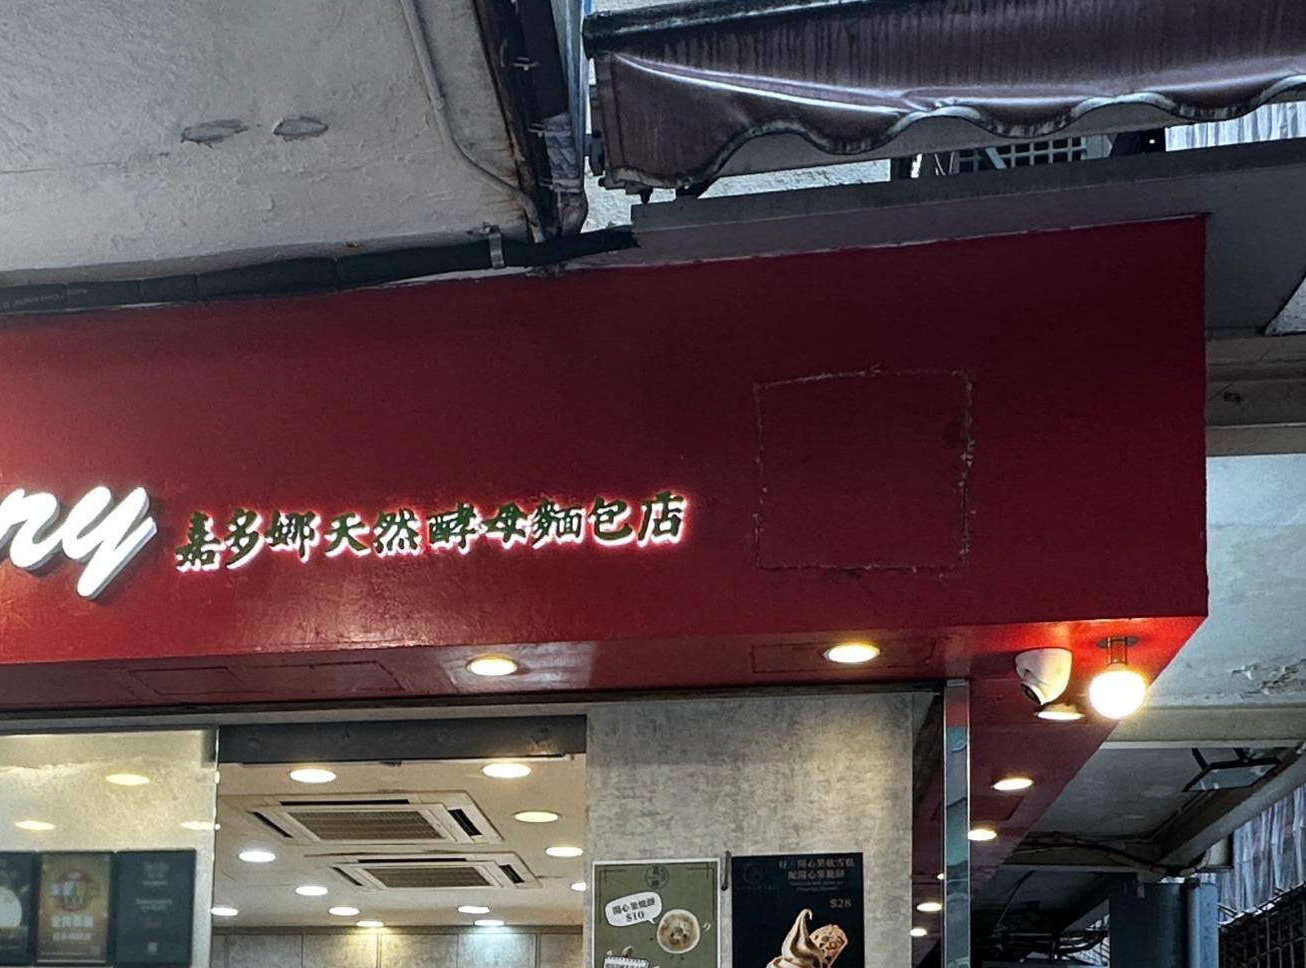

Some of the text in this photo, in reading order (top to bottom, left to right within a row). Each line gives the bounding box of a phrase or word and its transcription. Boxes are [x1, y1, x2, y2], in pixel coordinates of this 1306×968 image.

[176, 490, 688, 572] 嘉多娜天然酵母麵包店
[626, 911, 645, 922] $10
